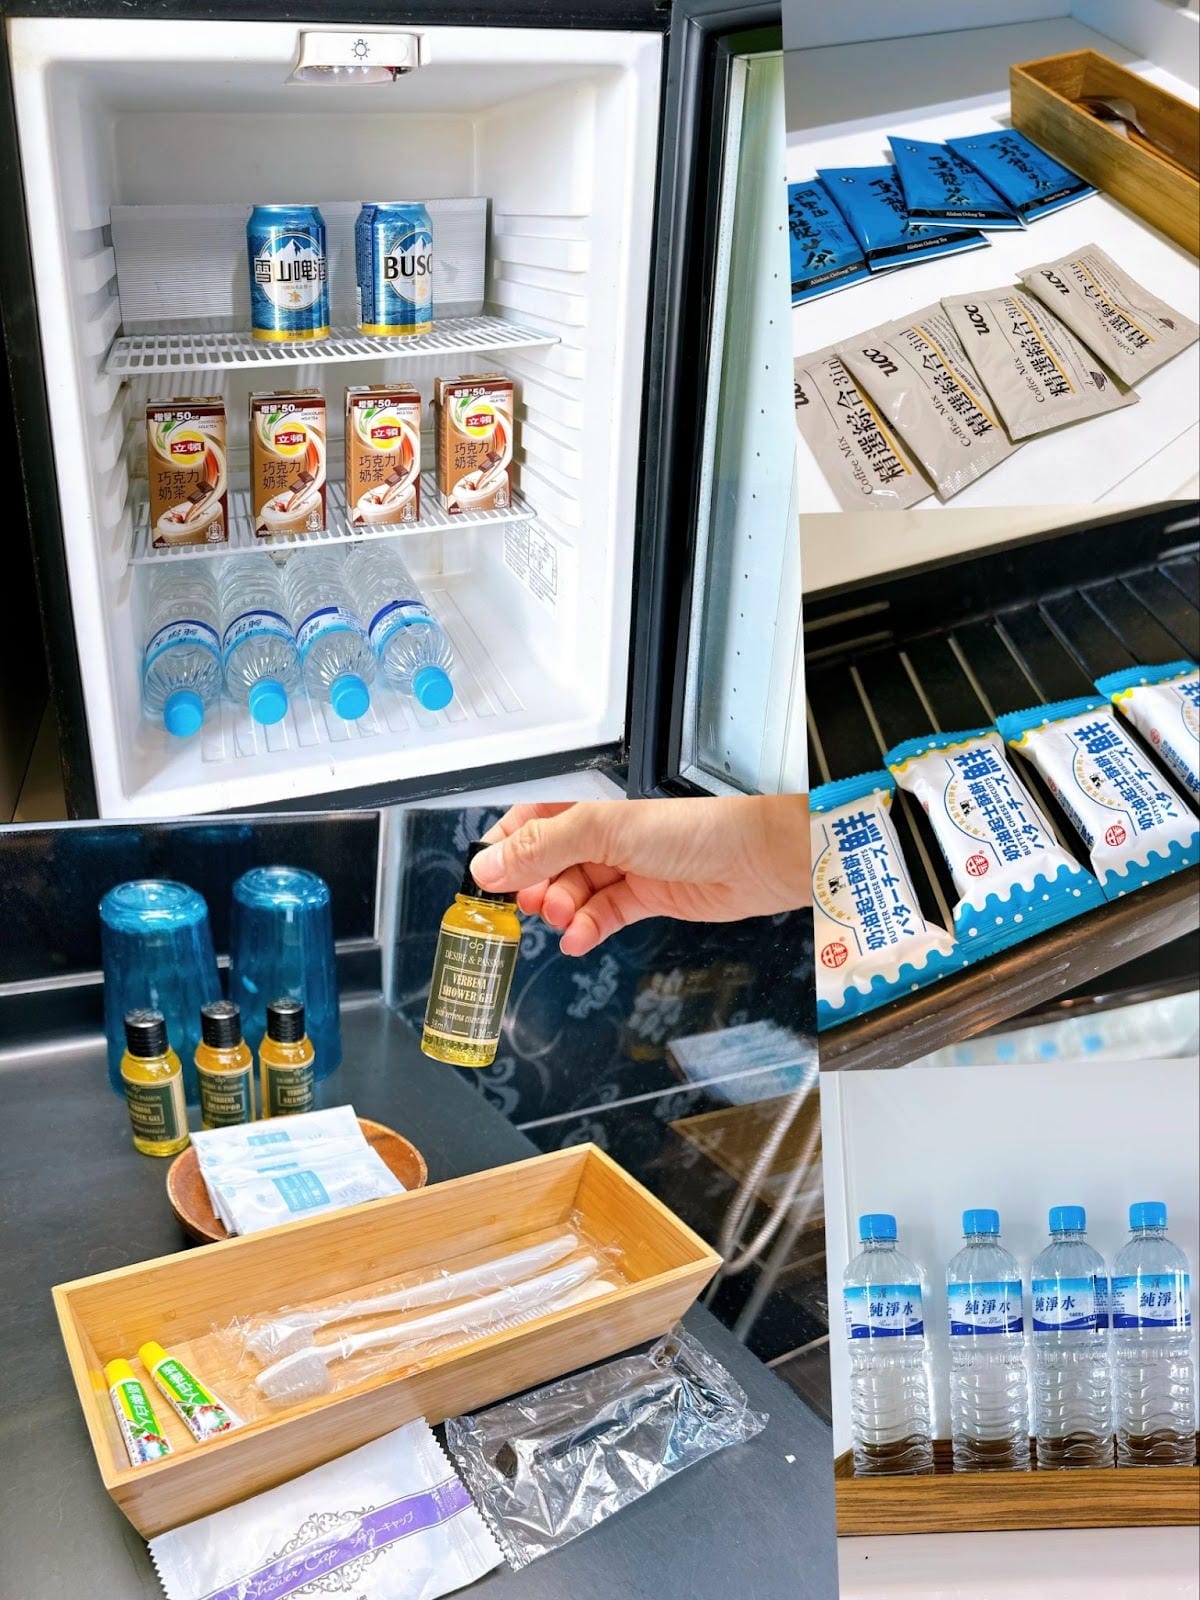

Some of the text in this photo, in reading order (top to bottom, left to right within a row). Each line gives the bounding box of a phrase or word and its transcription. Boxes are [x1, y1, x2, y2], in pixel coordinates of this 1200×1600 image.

[1013, 356, 1045, 403] Coffee Mix
[929, 394, 948, 415] Mix
[944, 415, 971, 447] Coffee
[455, 442, 490, 455] 巧克力
[263, 460, 301, 475] 巧克力
[359, 454, 396, 468] 巧克力
[455, 456, 477, 469] 奶茶
[837, 435, 873, 495] Coffee Mix
[158, 470, 200, 484] 巧克力
[263, 476, 288, 489] 奶茶
[359, 469, 384, 482] 奶茶
[158, 485, 186, 500] 奶茶
[1075, 721, 1123, 756] 鮮
[1108, 749, 1164, 824] BUTTER CHEESE BISCUITS
[1121, 745, 1177, 815] バターチーズ
[1093, 753, 1155, 830] 奶油起士酥餅
[953, 746, 1022, 862] 奶油起士酥餅 鮮
[994, 772, 1043, 848] バターチーズ
[984, 776, 1031, 856] BUTTER CHEESE BISCUITS
[831, 810, 887, 950] 奶油起士酥餅 鮮
[872, 843, 914, 934] バターチーズ
[860, 848, 897, 943] BUTTER CHEESE BISCUITS
[452, 972, 487, 990] VERBENA
[442, 984, 477, 1002] SHOWER
[869, 1301, 914, 1318] 純淨水
[964, 1299, 1011, 1316] 純淨水
[1035, 1295, 1076, 1312] 純淨水
[304, 1548, 341, 1571] Cap
